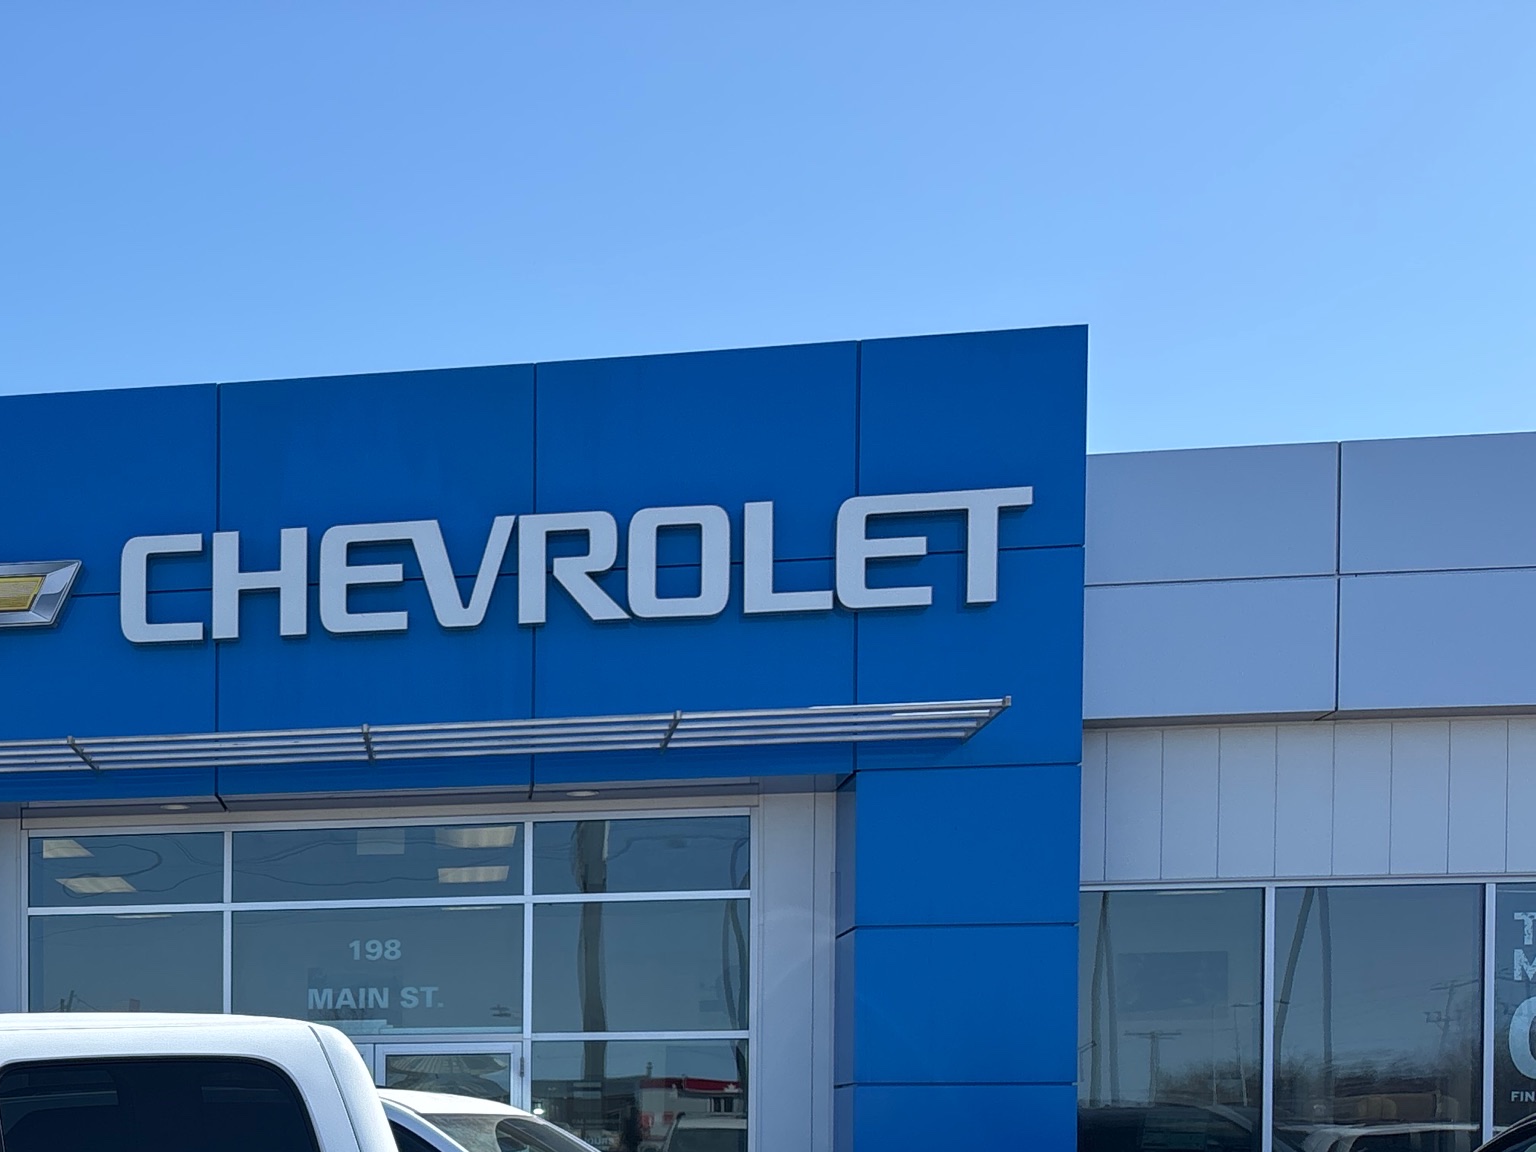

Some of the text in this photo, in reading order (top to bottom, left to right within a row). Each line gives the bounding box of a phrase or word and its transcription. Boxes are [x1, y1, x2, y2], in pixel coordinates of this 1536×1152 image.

[119, 486, 1034, 643] CHEVROLET
[349, 939, 402, 960] 198
[308, 986, 444, 1010] MAIN ST.
